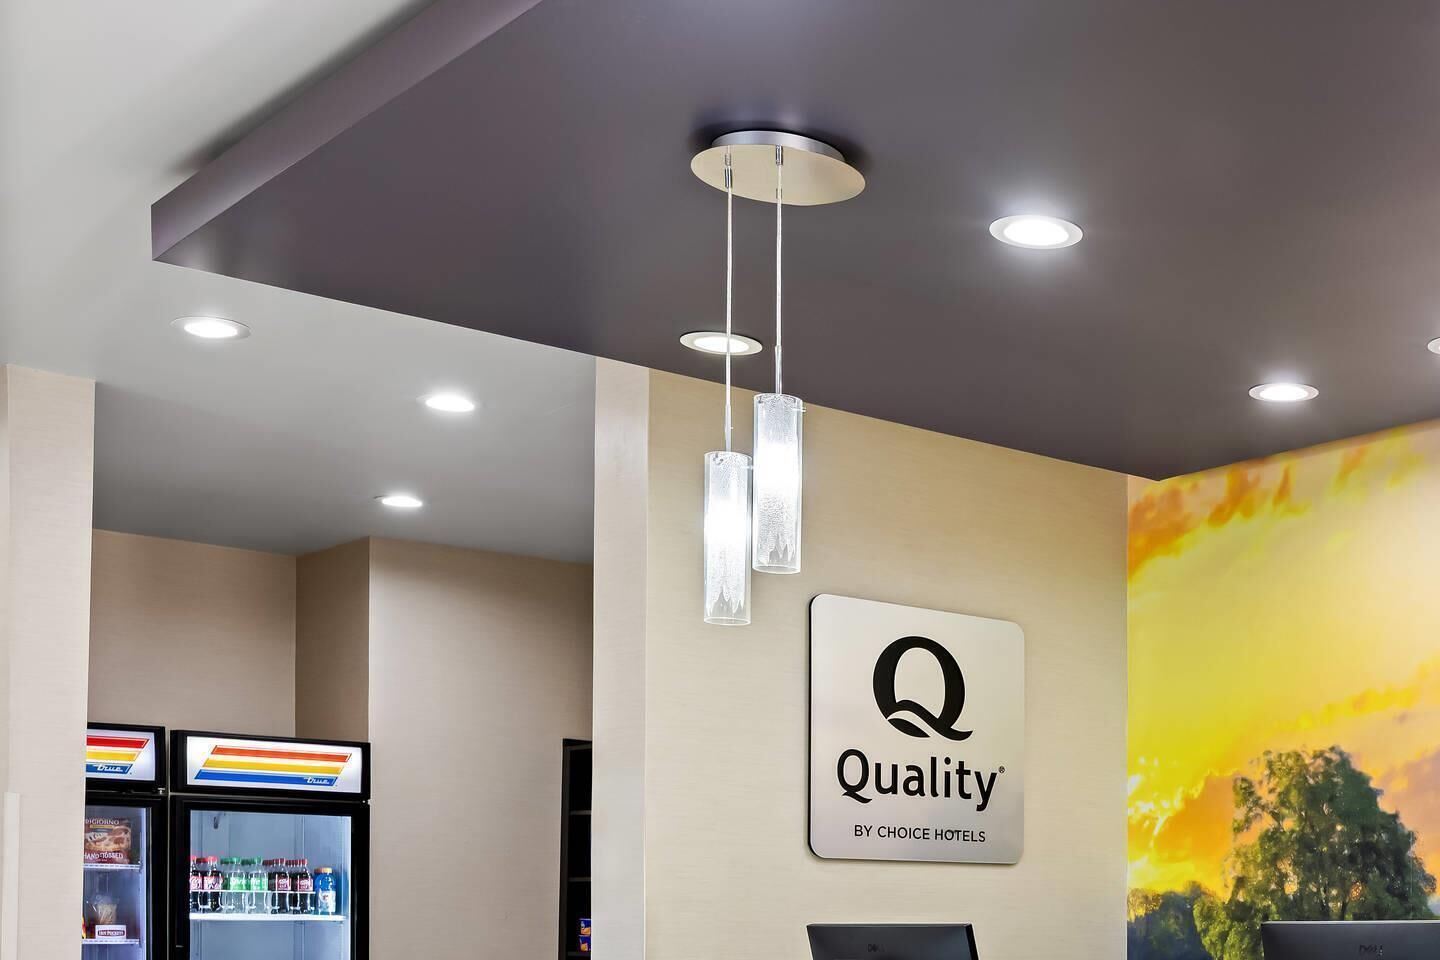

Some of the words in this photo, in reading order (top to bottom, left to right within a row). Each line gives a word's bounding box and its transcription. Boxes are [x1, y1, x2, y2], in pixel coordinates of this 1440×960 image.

[873, 635, 973, 741] Q
[854, 824, 872, 837] BY
[877, 826, 930, 840] CHOICE
[934, 829, 986, 842] HOTELS
